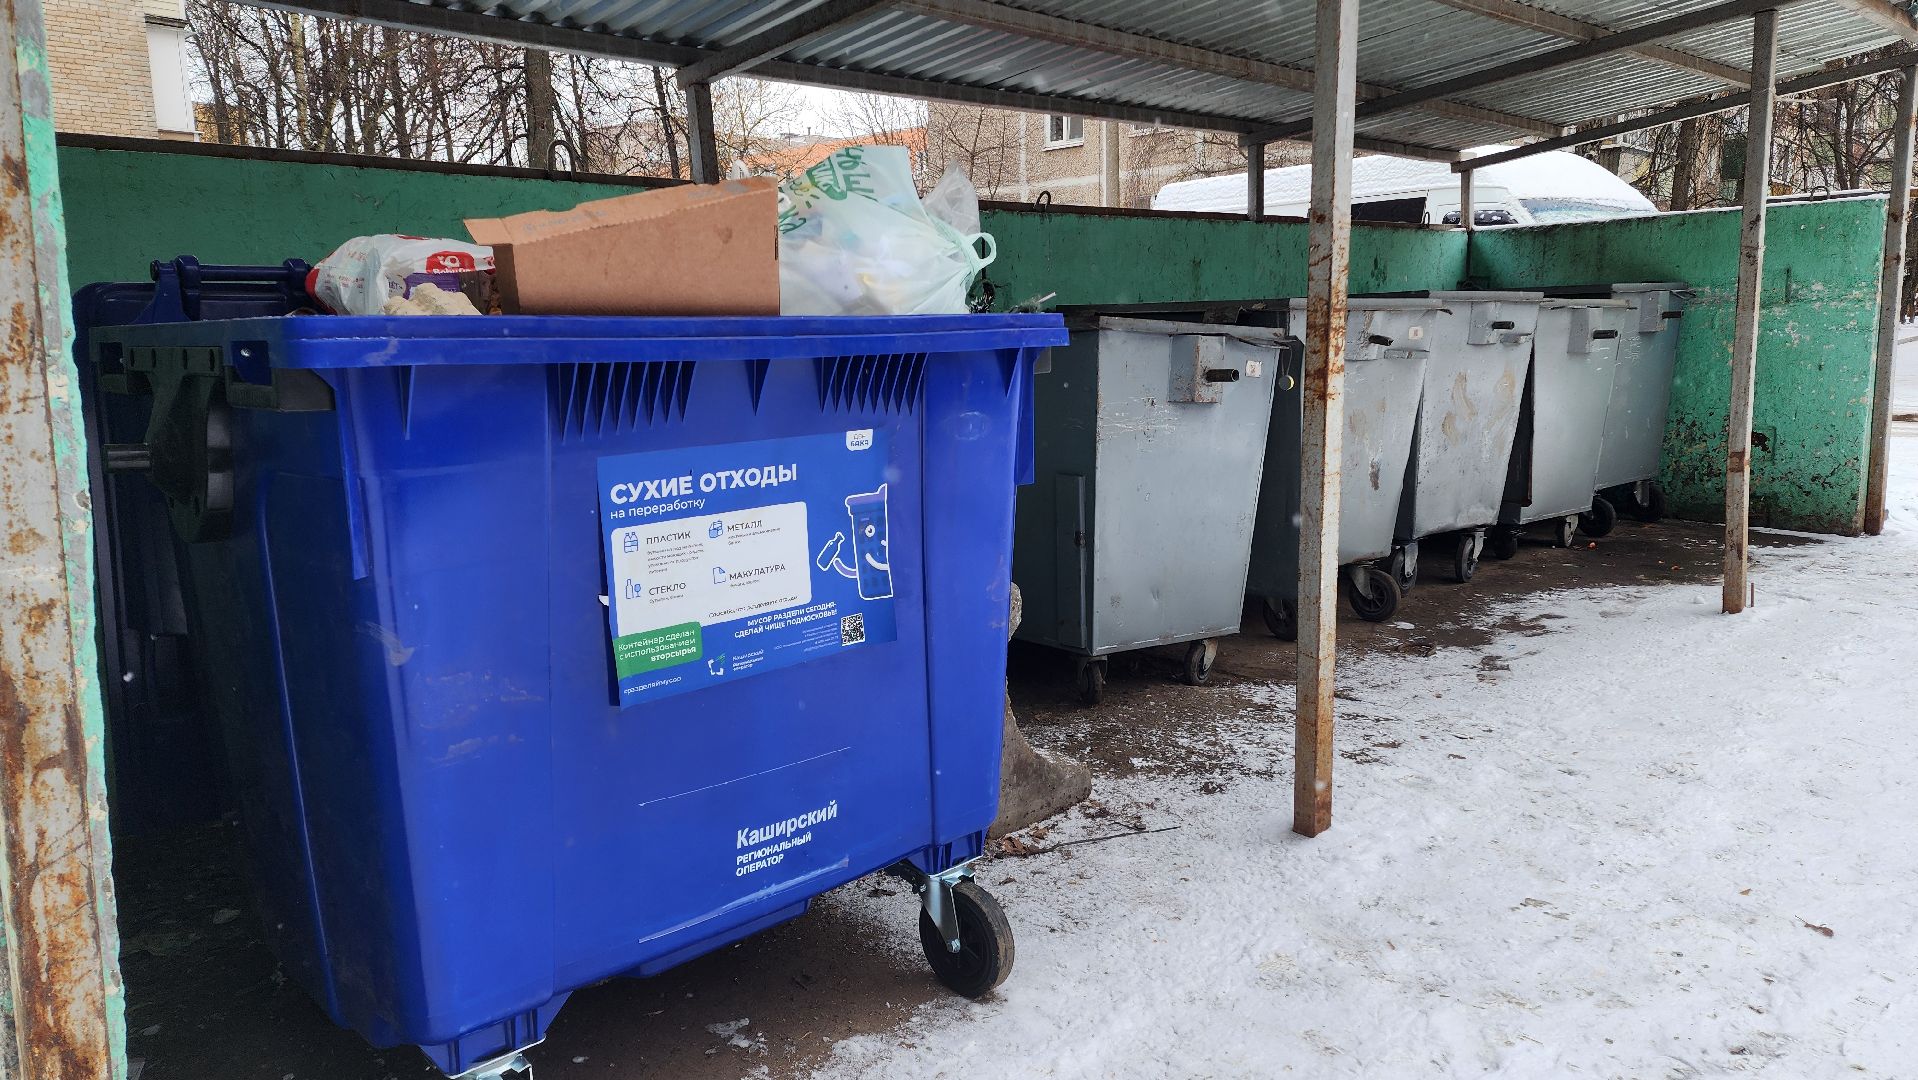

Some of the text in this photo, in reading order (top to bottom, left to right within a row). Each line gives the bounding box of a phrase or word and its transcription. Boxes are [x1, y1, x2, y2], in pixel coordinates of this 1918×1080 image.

[610, 463, 797, 505] СУХИЕ ОТХОДЫ
[610, 498, 706, 519] на переработку
[727, 520, 762, 532] МЕТАЛЛ
[646, 530, 691, 544] ПЛАСТИК
[729, 564, 786, 580] МАКУЛАТУРА
[648, 582, 686, 596] СТЕКЛО
[734, 624, 763, 638] СДЕЛАЙ
[786, 608, 837, 627] ПОДМОСКОВЬЕ!
[747, 615, 772, 627] МУСОР
[773, 608, 804, 621] РАЗДЕЛИ
[618, 629, 695, 651] Контейнер сделан
[624, 638, 696, 659] использованием
[650, 647, 697, 662] вторсырья
[736, 799, 838, 849] Каширский
[736, 830, 812, 866] РЕГИОНАЛЬНЫЙ
[735, 853, 784, 877] ОПЕРАТОР
